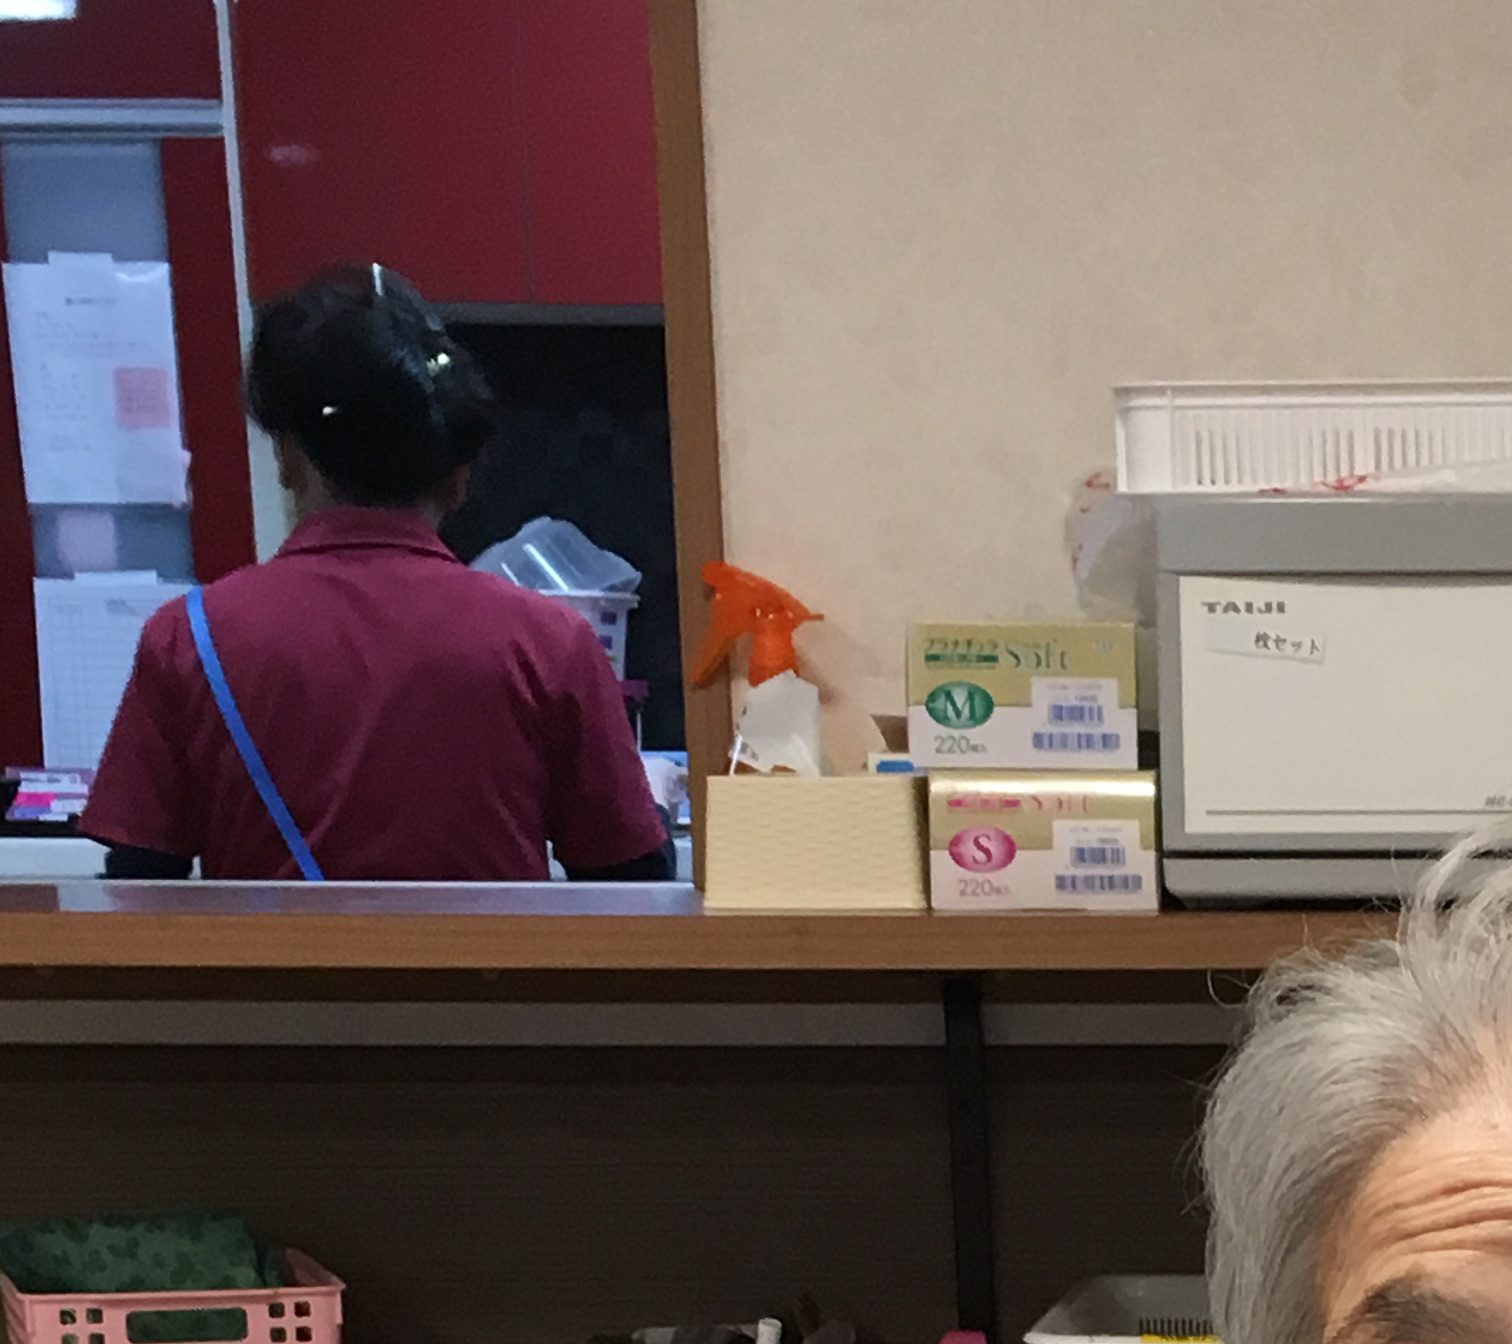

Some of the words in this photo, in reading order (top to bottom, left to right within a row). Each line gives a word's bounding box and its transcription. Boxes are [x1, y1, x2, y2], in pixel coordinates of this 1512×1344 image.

[1200, 601, 1285, 614] TAIJI
[945, 689, 977, 721] M
[972, 834, 993, 866] S
